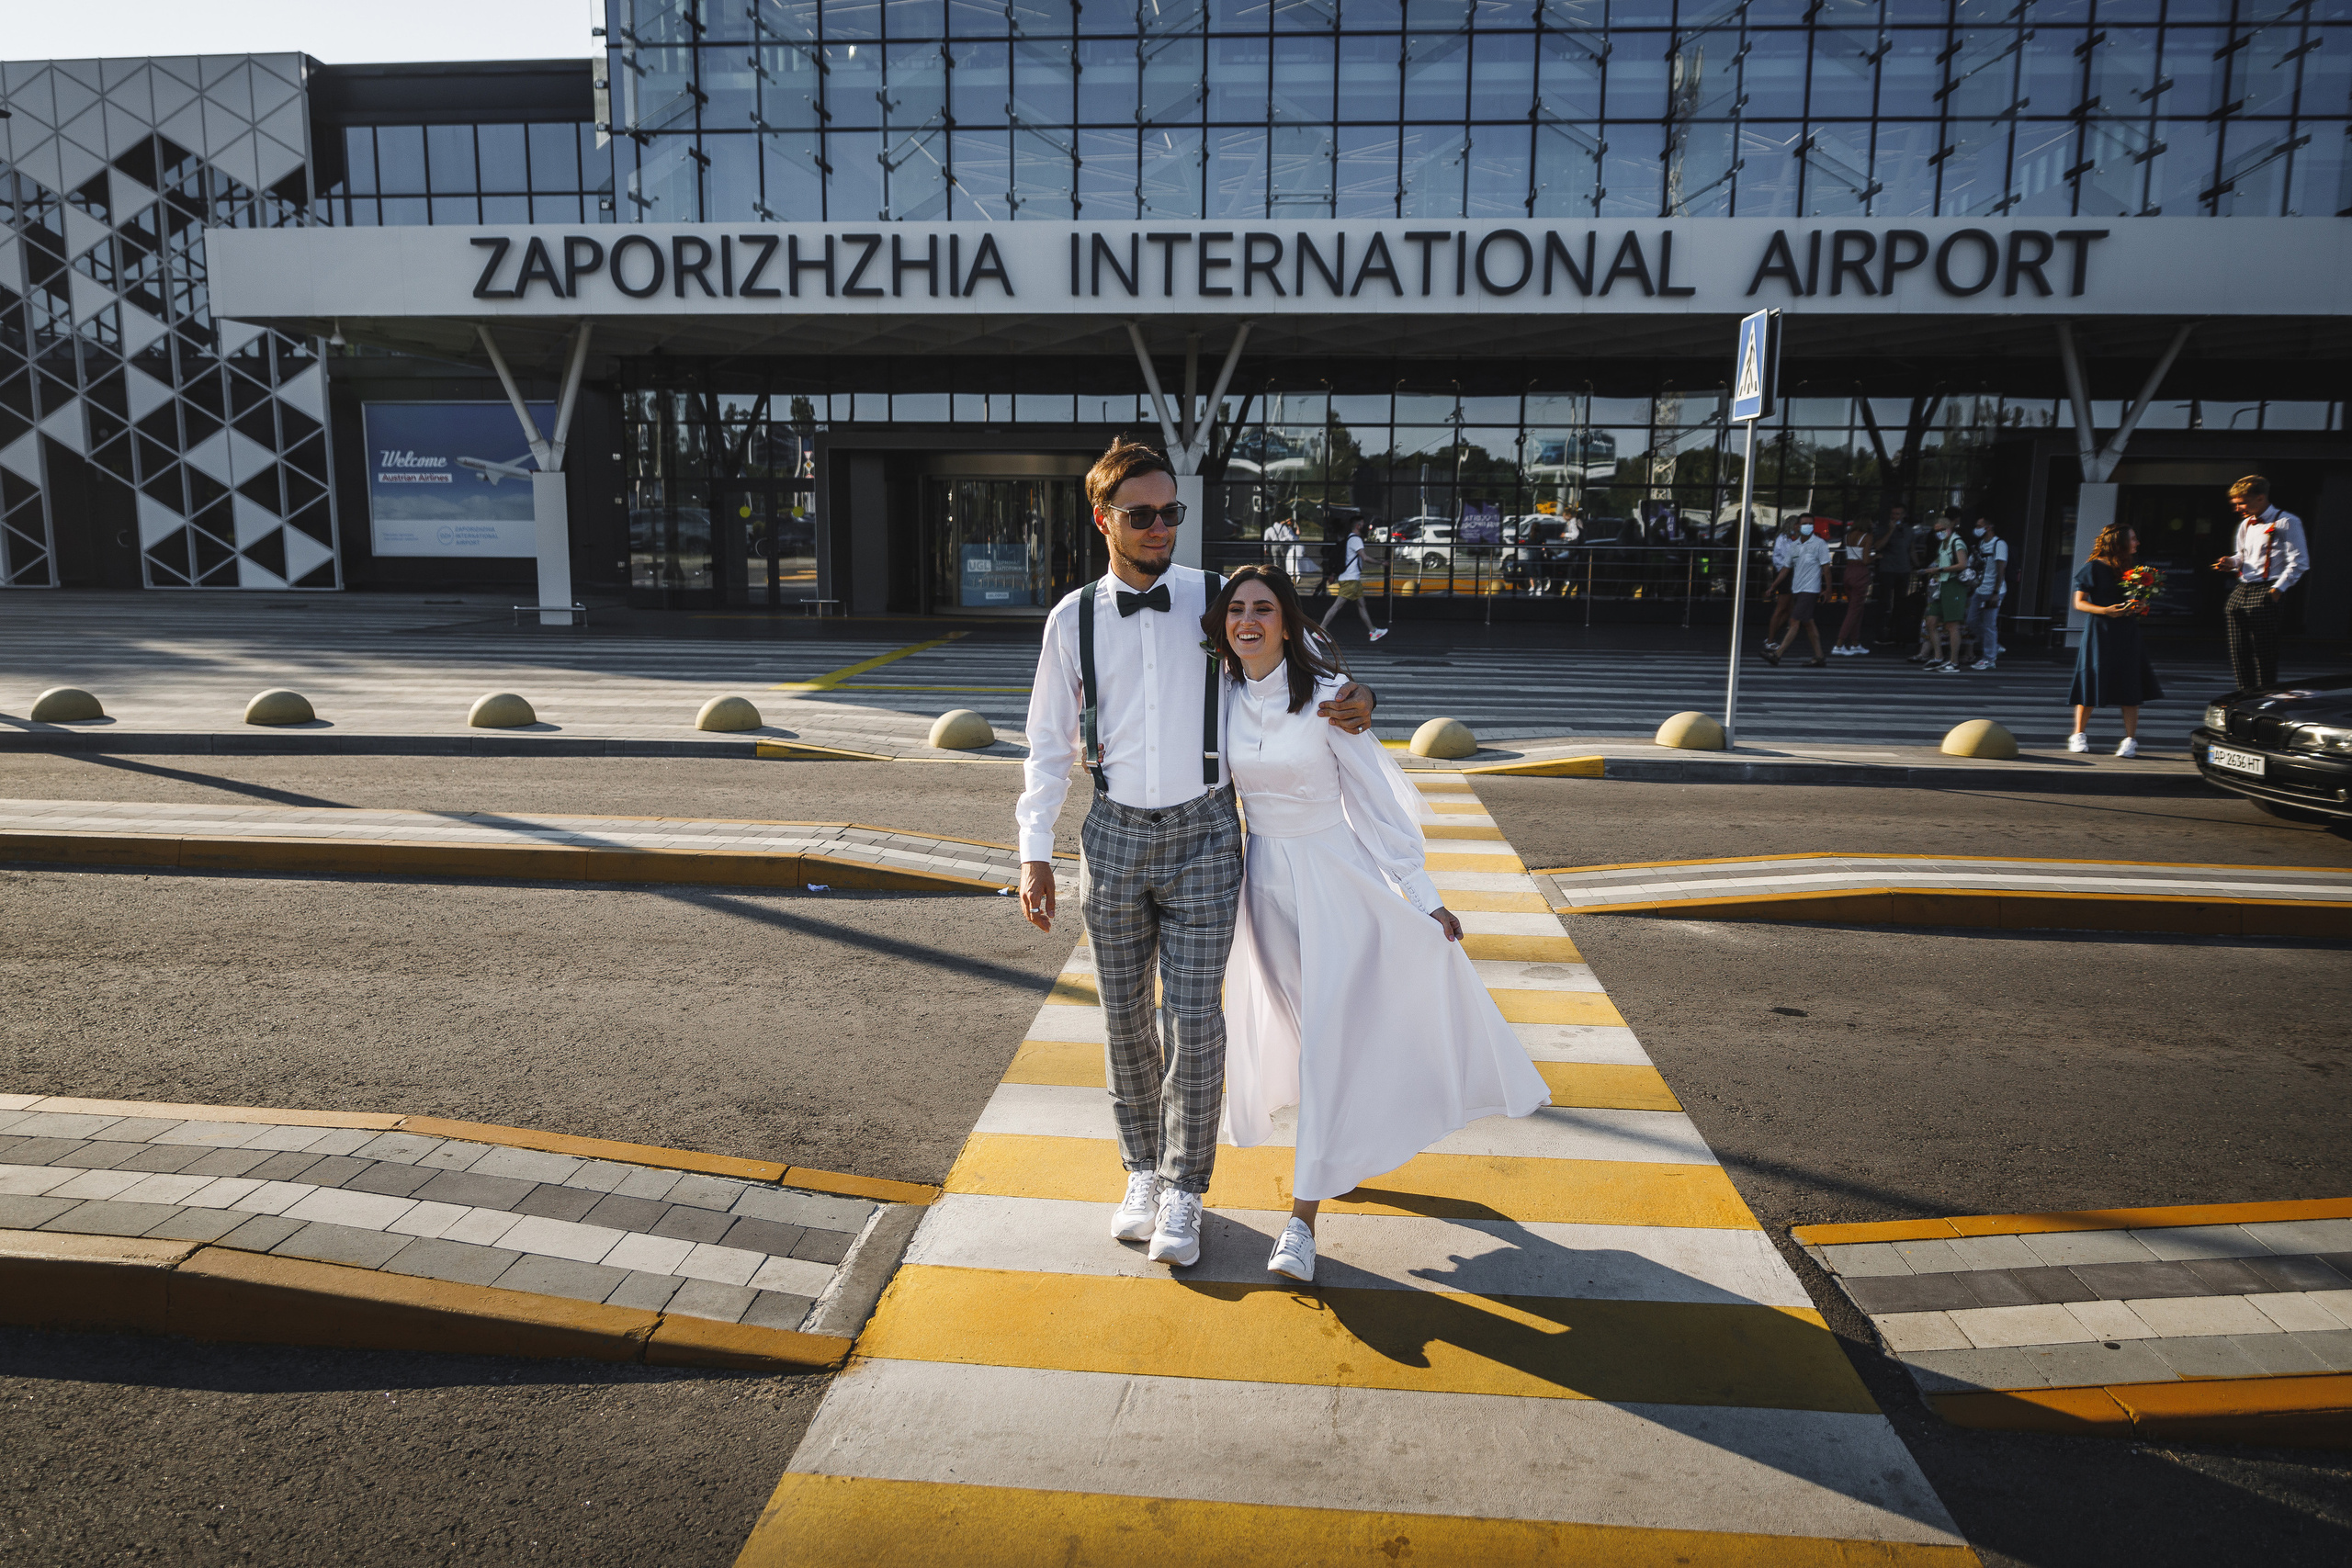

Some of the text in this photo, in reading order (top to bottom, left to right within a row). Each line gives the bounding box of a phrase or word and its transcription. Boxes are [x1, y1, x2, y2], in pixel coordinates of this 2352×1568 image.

[469, 228, 2110, 299] ZAPORIZHZHIA INTERNATIONAL AIRPORT
[380, 450, 447, 468] Welcome
[382, 473, 448, 481] Austrian Airlines
[969, 561, 989, 570] UGL
[2214, 750, 2261, 772] AP 2636 HT
